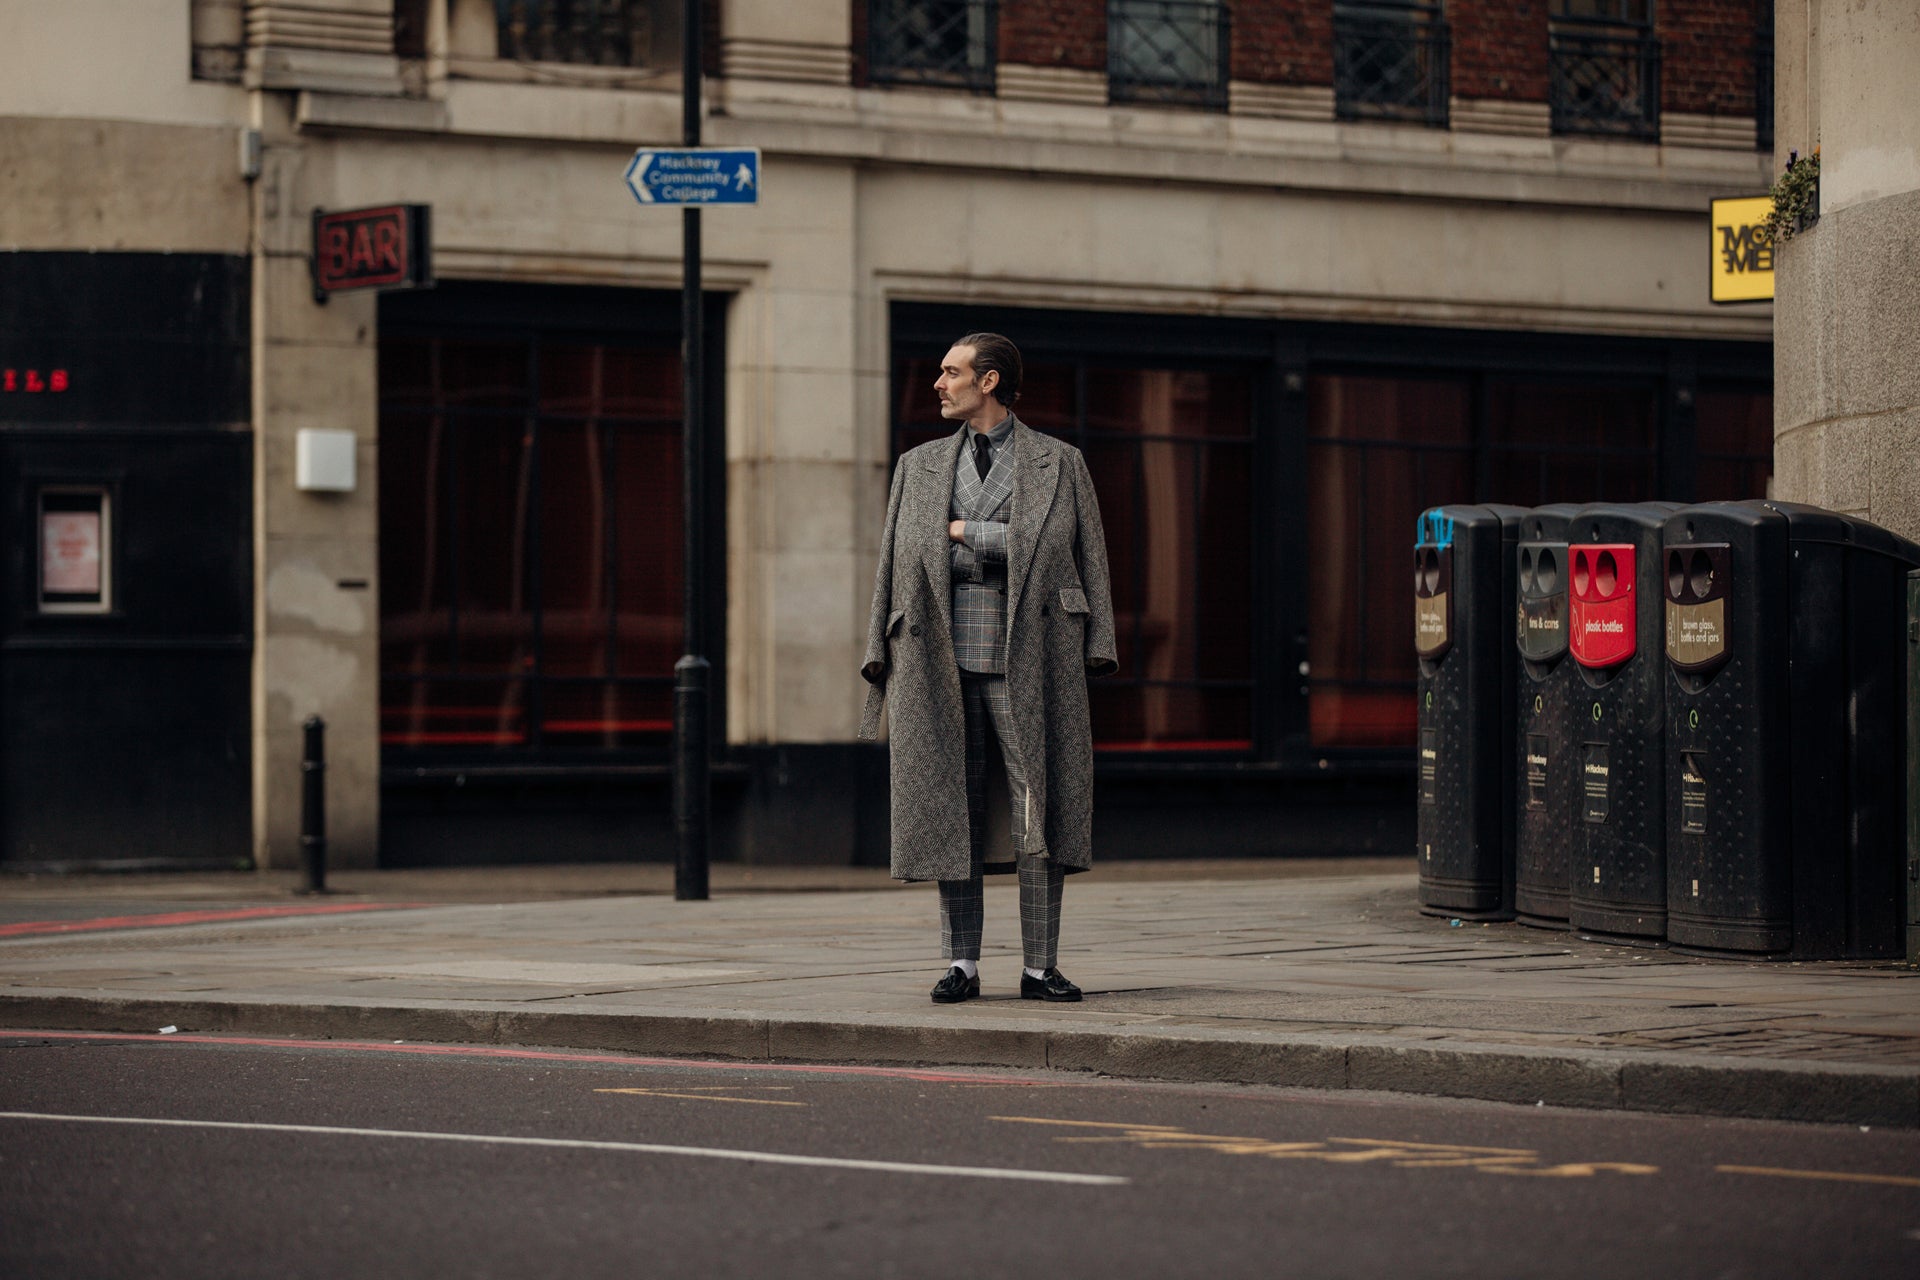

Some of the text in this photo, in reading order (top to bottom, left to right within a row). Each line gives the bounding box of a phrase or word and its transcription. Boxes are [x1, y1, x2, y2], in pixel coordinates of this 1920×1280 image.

[659, 156, 720, 172] Hackney
[649, 170, 730, 186] Community
[662, 186, 718, 201] College
[327, 220, 400, 277] BAR
[1585, 619, 1624, 635] plastic bottles
